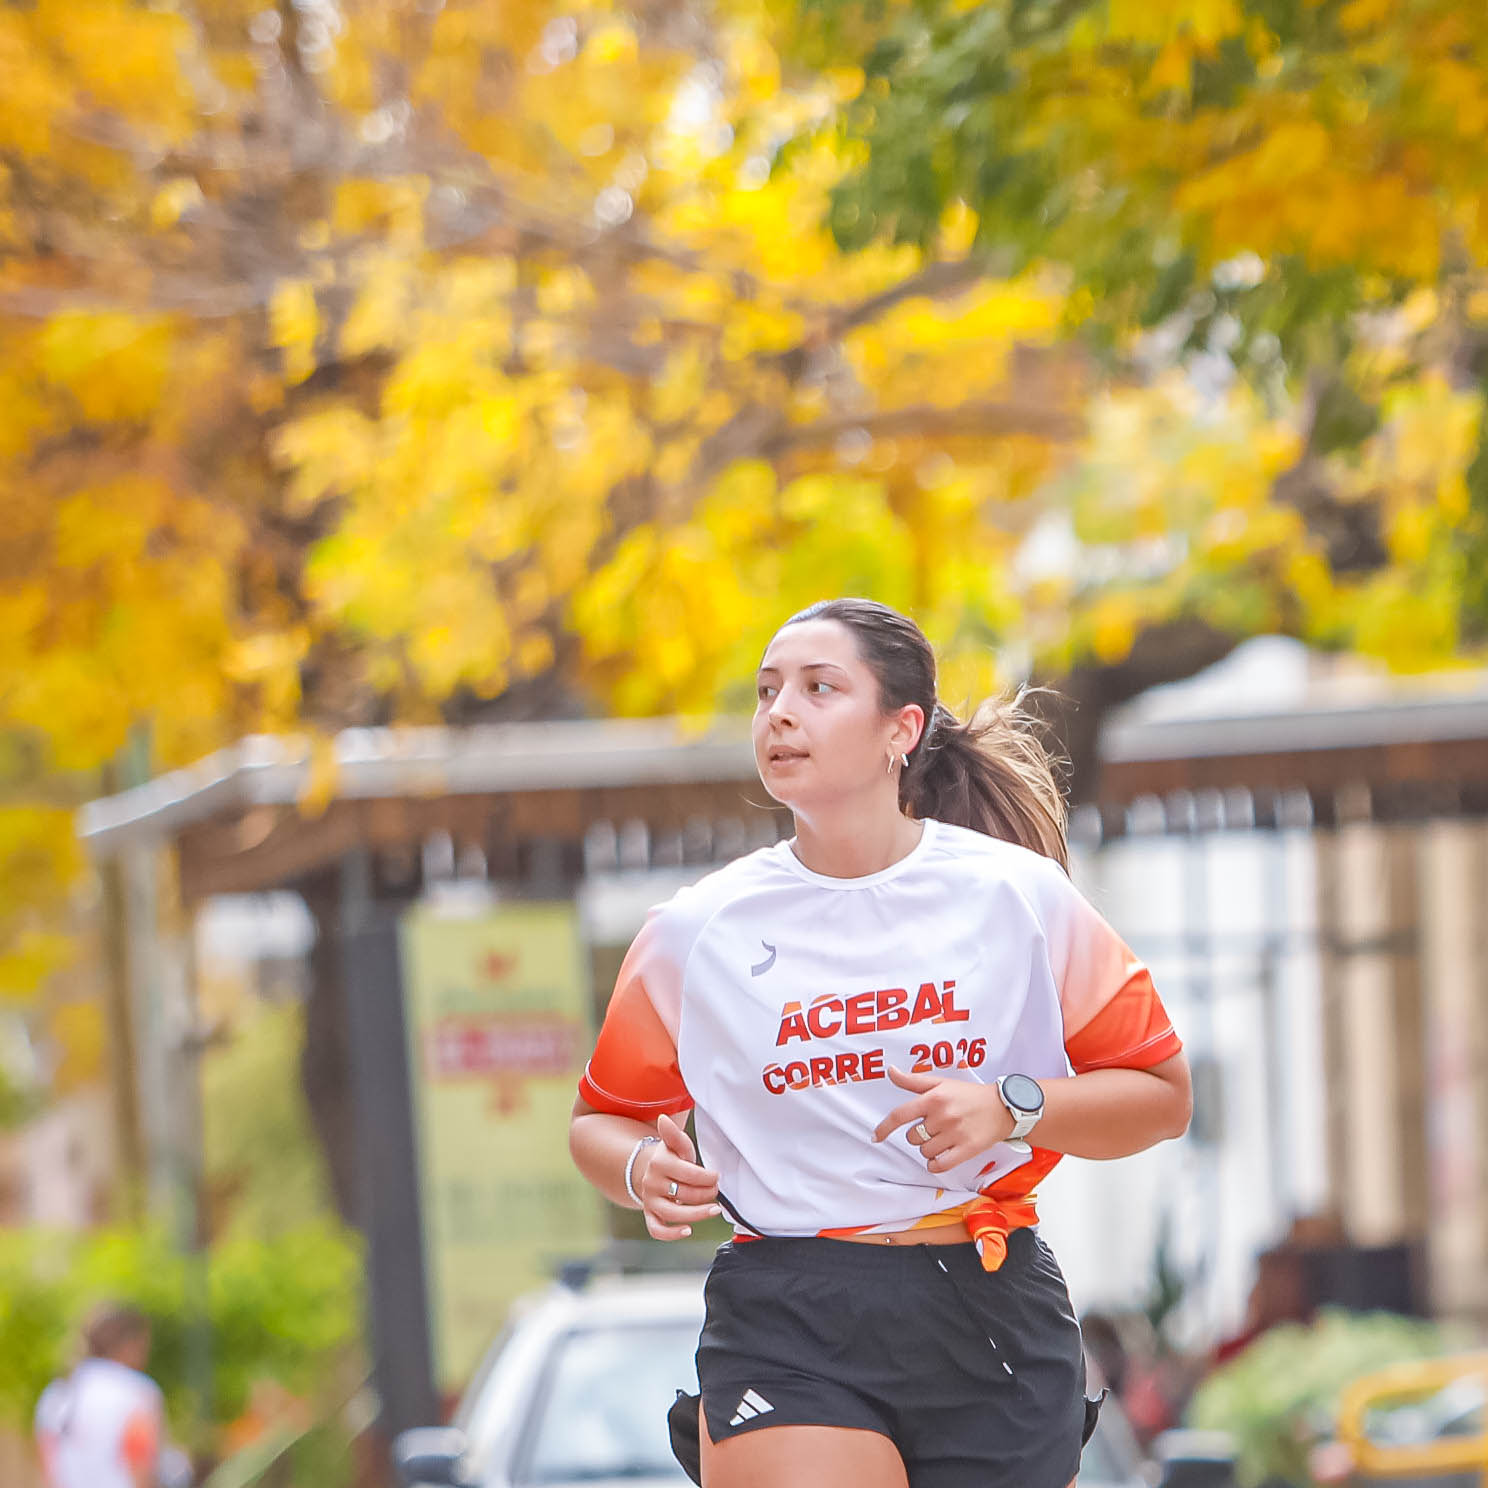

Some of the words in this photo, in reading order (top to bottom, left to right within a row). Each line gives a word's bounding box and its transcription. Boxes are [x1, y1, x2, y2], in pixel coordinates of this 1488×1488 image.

[776, 980, 970, 1046] ACEBAL
[762, 1049, 886, 1095] CORRE
[910, 1038, 987, 1073] 2026
